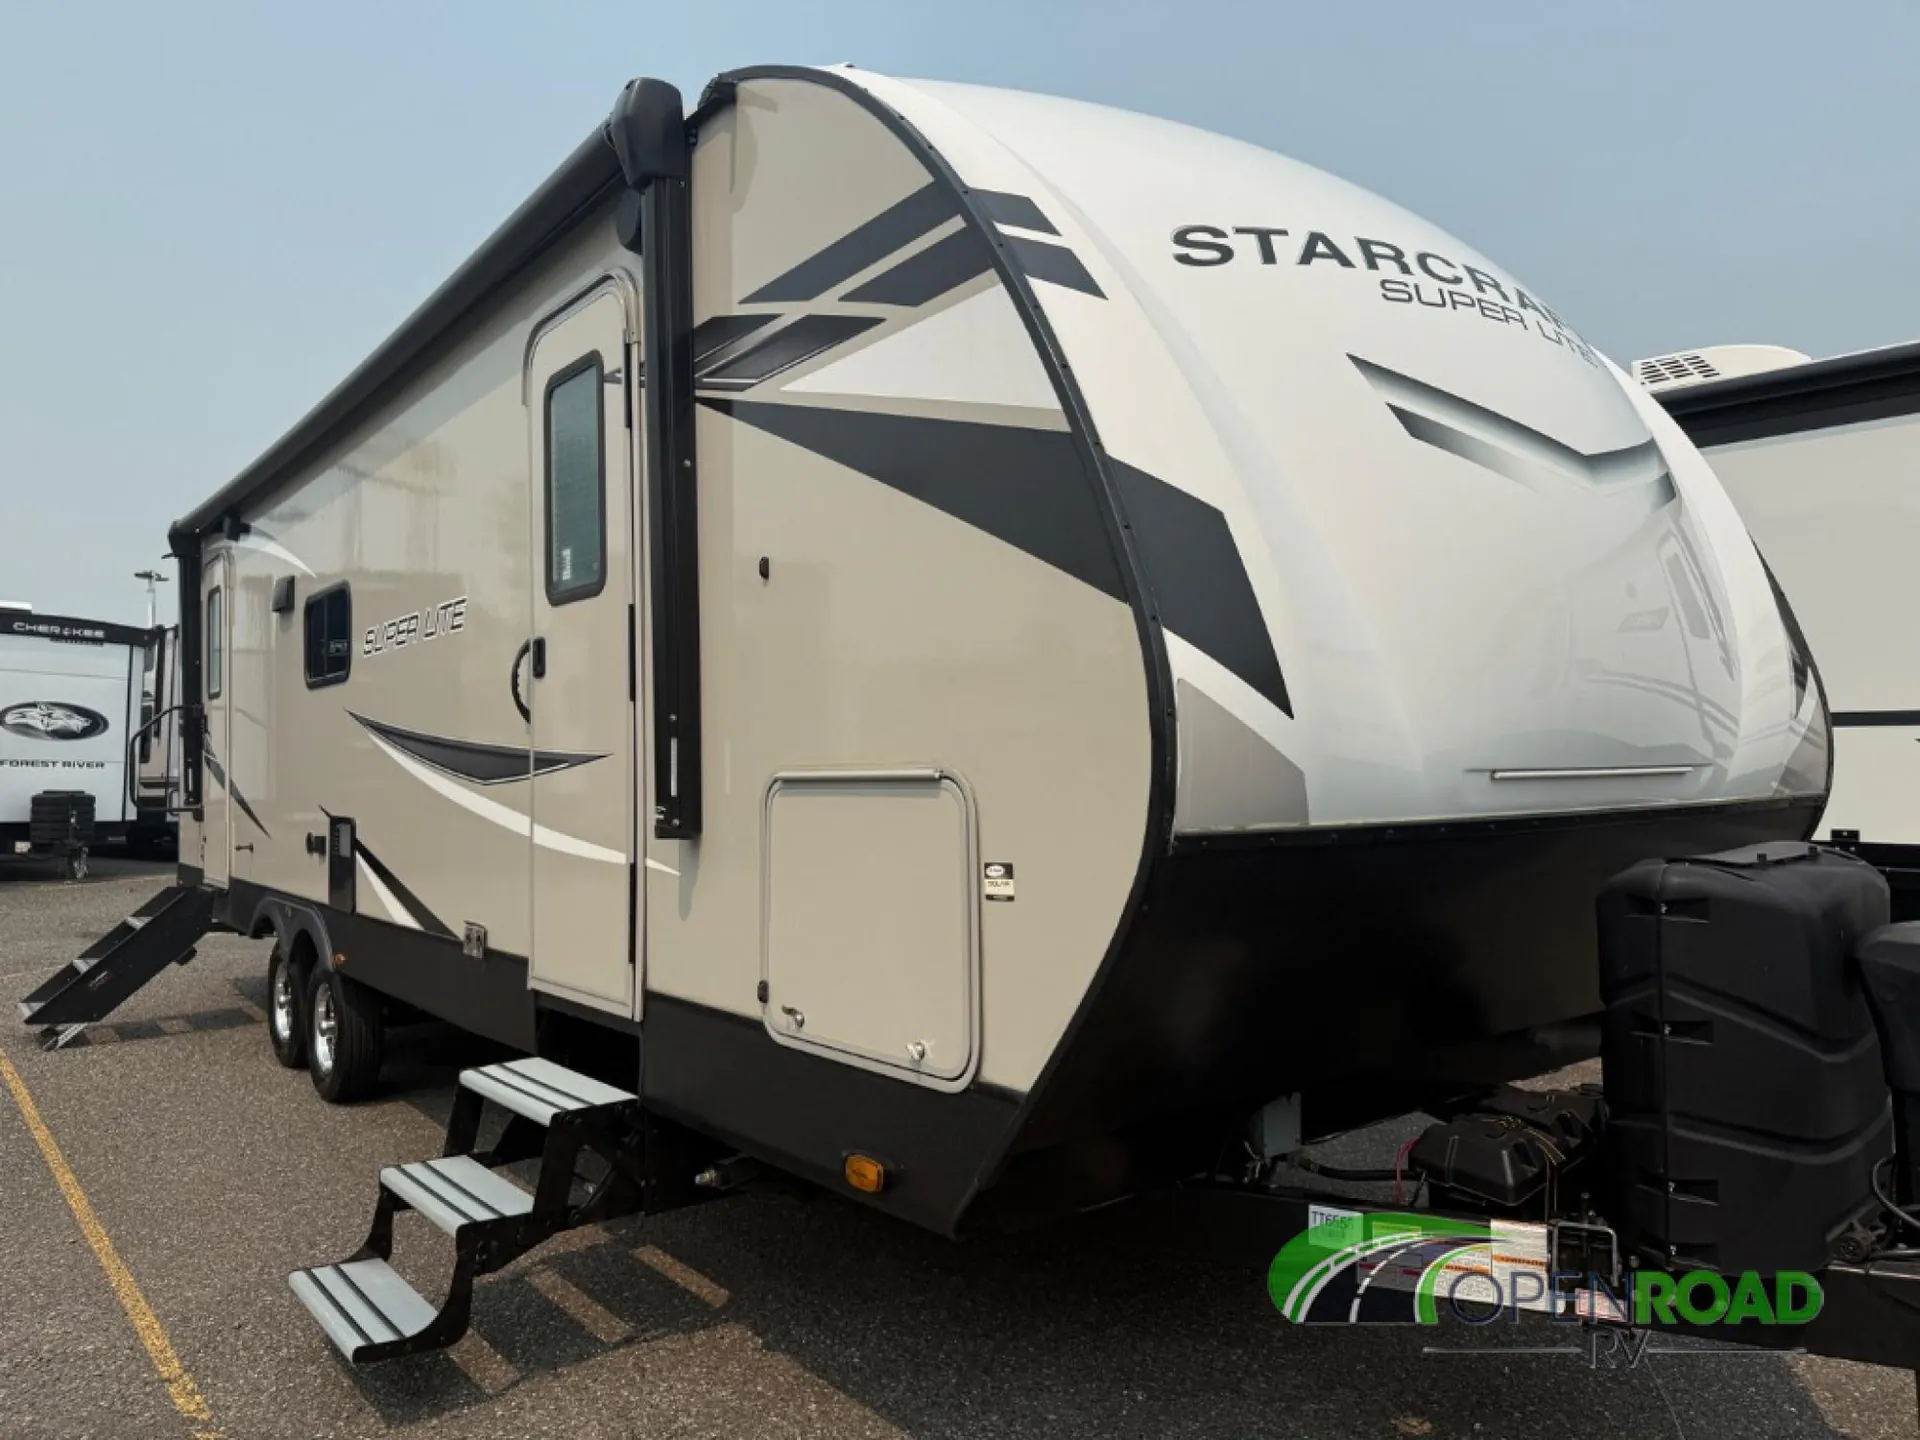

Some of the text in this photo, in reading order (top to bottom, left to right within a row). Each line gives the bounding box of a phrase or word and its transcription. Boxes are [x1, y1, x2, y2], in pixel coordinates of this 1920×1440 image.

[1379, 277, 1528, 331] SUPER
[12, 621, 105, 638] CHEROKEE
[363, 596, 468, 657] SUPER LITE
[0, 759, 105, 769] FOREST RIVER
